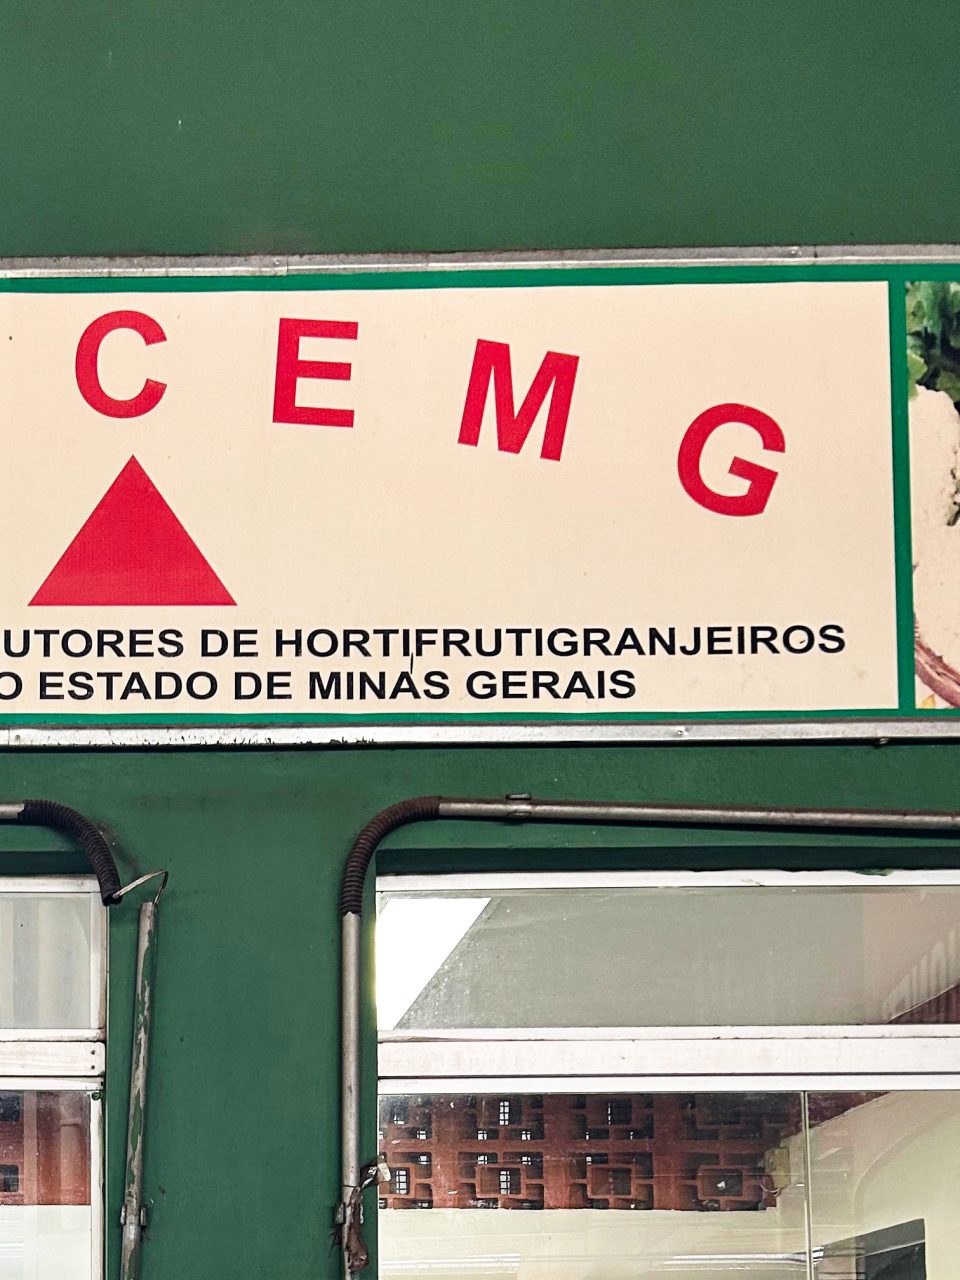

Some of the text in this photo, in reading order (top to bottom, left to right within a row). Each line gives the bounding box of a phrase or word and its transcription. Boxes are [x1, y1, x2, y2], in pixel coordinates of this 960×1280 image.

[201, 629, 259, 659] DE
[276, 624, 846, 658] HORTIFRUTIGRANJEIROS
[41, 672, 218, 702] ESTADO
[236, 672, 293, 701] DE
[308, 670, 451, 701] MINAS
[466, 669, 637, 701] GERAIS
